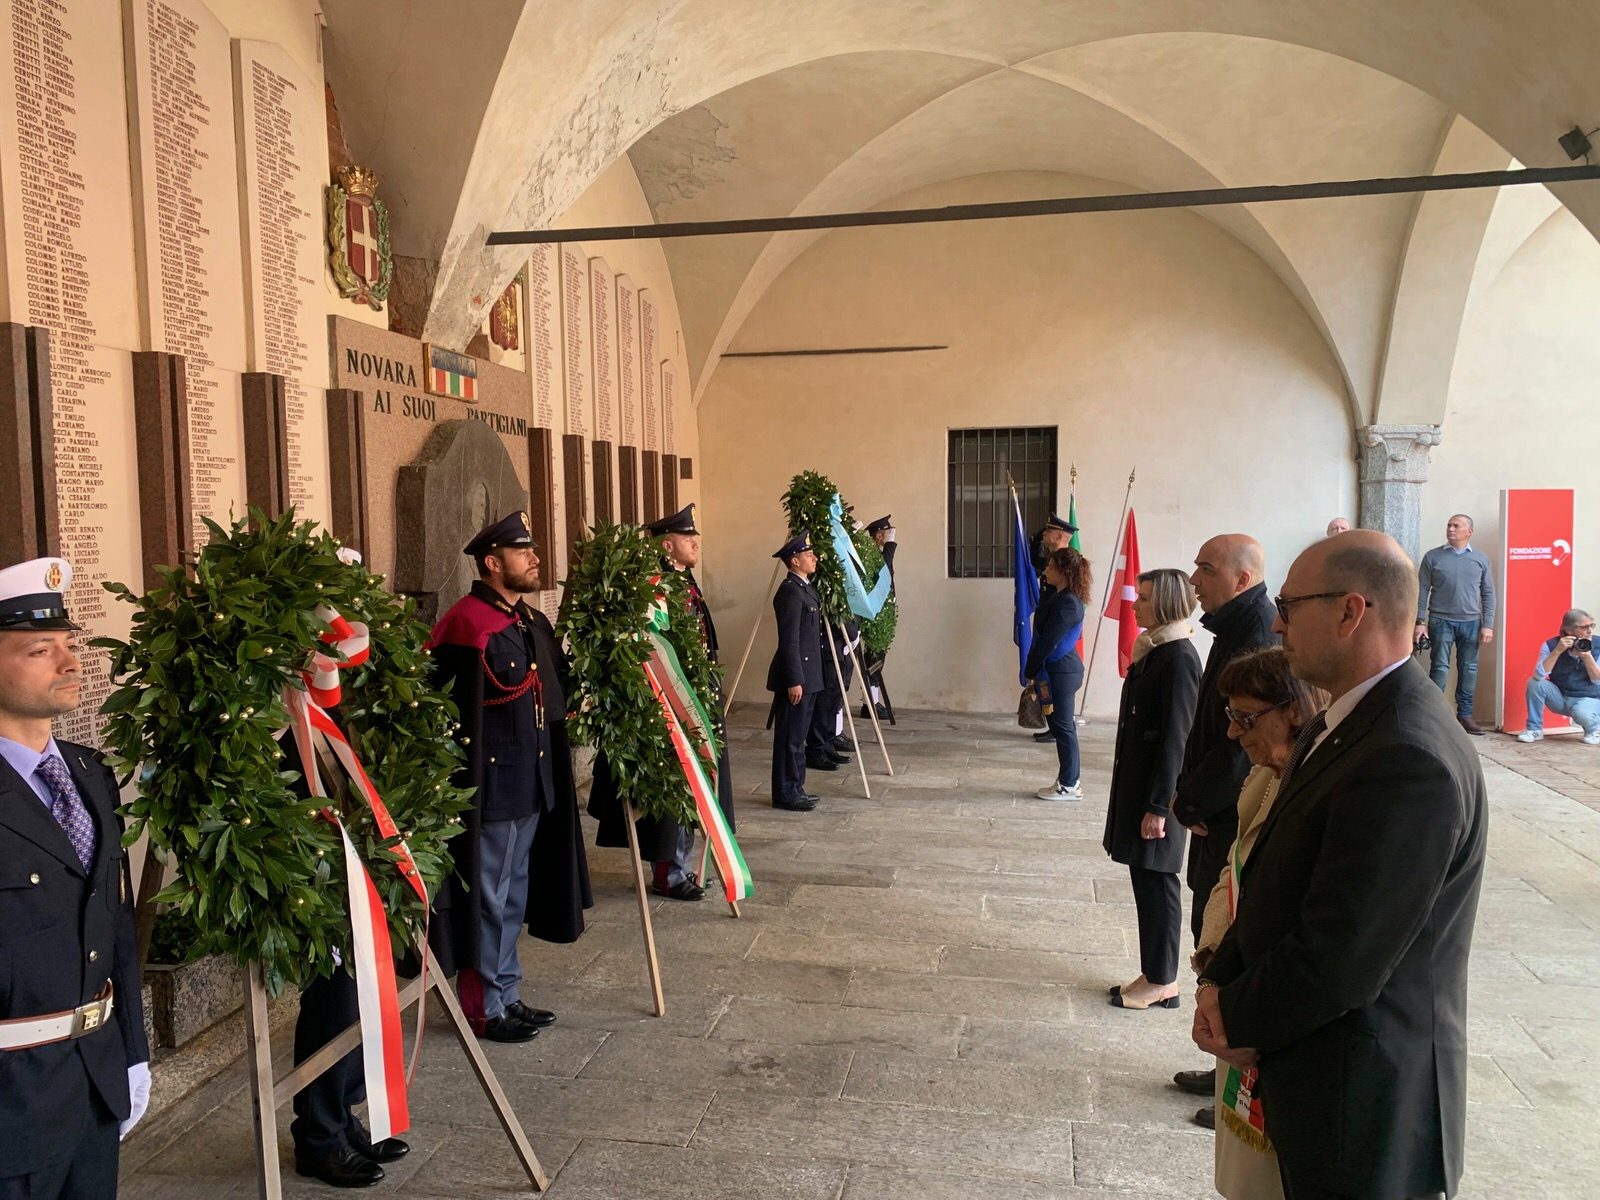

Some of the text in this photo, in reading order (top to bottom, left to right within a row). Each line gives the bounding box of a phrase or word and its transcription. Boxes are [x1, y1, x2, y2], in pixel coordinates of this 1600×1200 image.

[38, 2, 53, 15] LUCA
[40, 12, 61, 26] RENZO
[36, 18, 72, 40] GAUDENZIO
[12, 23, 63, 52] CERUTTI BRUNO
[13, 32, 73, 65] CERUTTI ERMELINA
[13, 40, 68, 71] CERUTTI FRANCO
[14, 49, 74, 81] CERUTTI GUERRINO
[14, 58, 73, 89] CERUTTI LORENZO
[14, 66, 41, 83] CERUTTI
[35, 84, 58, 99] ETTORE
[16, 93, 61, 116] CHIARA ALDO
[47, 97, 76, 114] SEVERINO
[16, 101, 64, 126] CHIODO SILVIO
[17, 110, 76, 139] CIANO FRANCESCO
[47, 131, 74, 147] GIUSEPPE
[48, 139, 76, 155] BATTISTA
[52, 149, 69, 160] ALDO
[19, 145, 68, 167] CIOCCA CARLO
[19, 153, 82, 181] CITTERIO GIOVANNI
[59, 176, 85, 191] GIUSEPPE
[21, 180, 84, 205] CLEMENTE ERNESTO
[56, 200, 79, 212] ANGELO
[61, 209, 81, 221] EMILIO
[61, 217, 80, 228] MARIO
[24, 223, 71, 241] COLLI ANGELO
[44, 220, 69, 233] AURELIO
[24, 231, 73, 250] COLLI ROMOLO
[25, 240, 86, 261] COLOMBO ALFREDO
[25, 249, 56, 261] COLOMBO
[26, 257, 88, 278] COLOMBO ANTONIO
[27, 266, 90, 287] COLOMBO AQUILINO
[27, 274, 88, 294] COLOMBO ERNESTO
[28, 283, 86, 302] COLOMBO FRANCO
[28, 292, 83, 309] COLOMBO MARIO
[29, 300, 86, 317] COLOMBO PIERINO
[29, 308, 92, 326] COLOMBO VITTORIO
[61, 331, 89, 341] SEVERINO
[71, 325, 96, 336] GIUSEPPE
[190, 329, 209, 338] ALBERTO
[60, 340, 94, 351] GIANMARIO
[179, 334, 200, 343] GIUSEPPE
[60, 348, 84, 358] LUIGINO
[60, 356, 89, 366] VITTORIO
[346, 348, 416, 387] NOVARA
[79, 376, 104, 384] AUGUSTO
[81, 368, 111, 378] AMBROGIO
[193, 378, 218, 387] NAPOLEONE
[57, 389, 77, 397] CARLO
[58, 397, 86, 406] CESARINA
[374, 390, 391, 414] AI
[403, 395, 436, 422] SUOI
[57, 421, 84, 429] ADRIANO
[62, 470, 99, 478] COSTANTINO
[78, 612, 106, 620] GIOVANNI
[82, 667, 101, 675] MARIO
[86, 689, 111, 698] GIUSEPPE
[63, 710, 78, 719] GIULI
[67, 716, 91, 726] GRANDE
[67, 724, 91, 735] GRANDE
[68, 732, 91, 741] GRANDE
